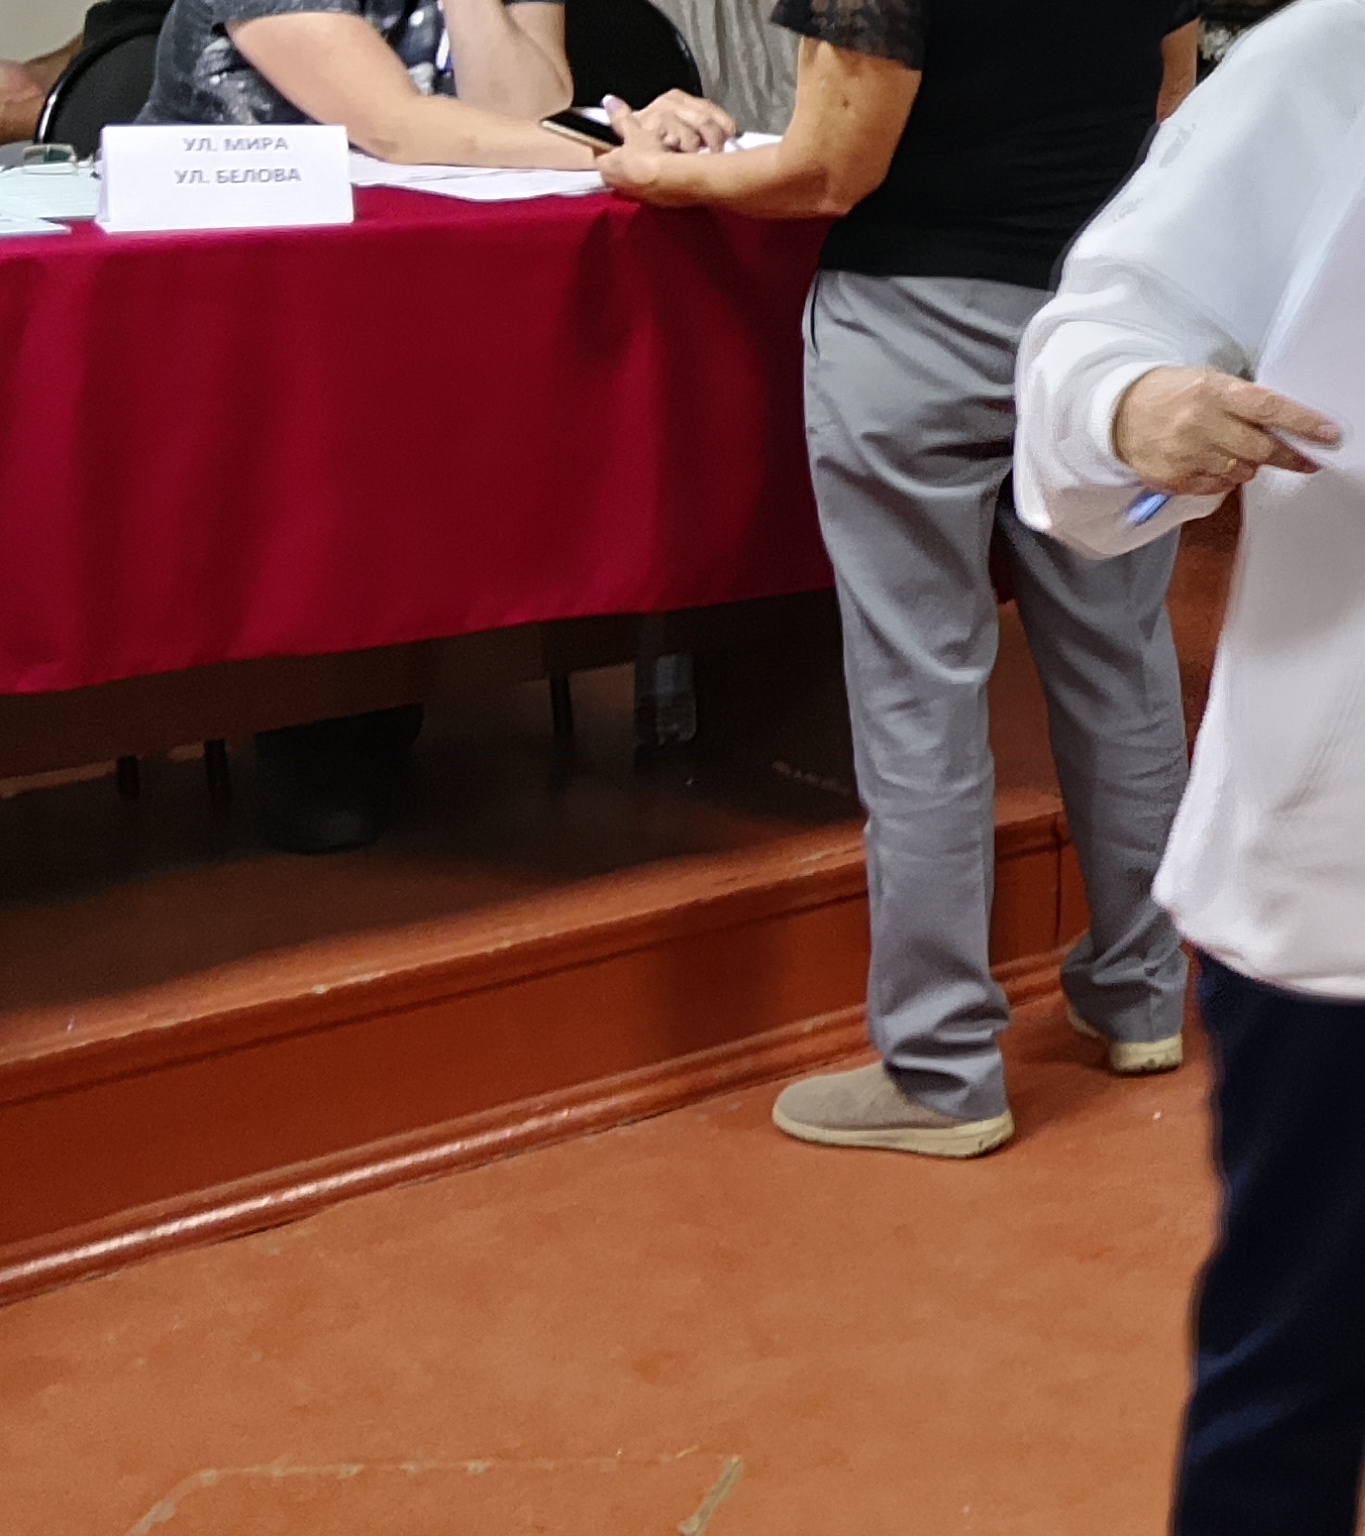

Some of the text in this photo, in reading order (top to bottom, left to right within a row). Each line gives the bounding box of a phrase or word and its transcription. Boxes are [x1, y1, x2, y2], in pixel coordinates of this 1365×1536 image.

[183, 136, 289, 152] УЛ. МИРА
[174, 167, 302, 184] УЛ. БЕЛОВА
